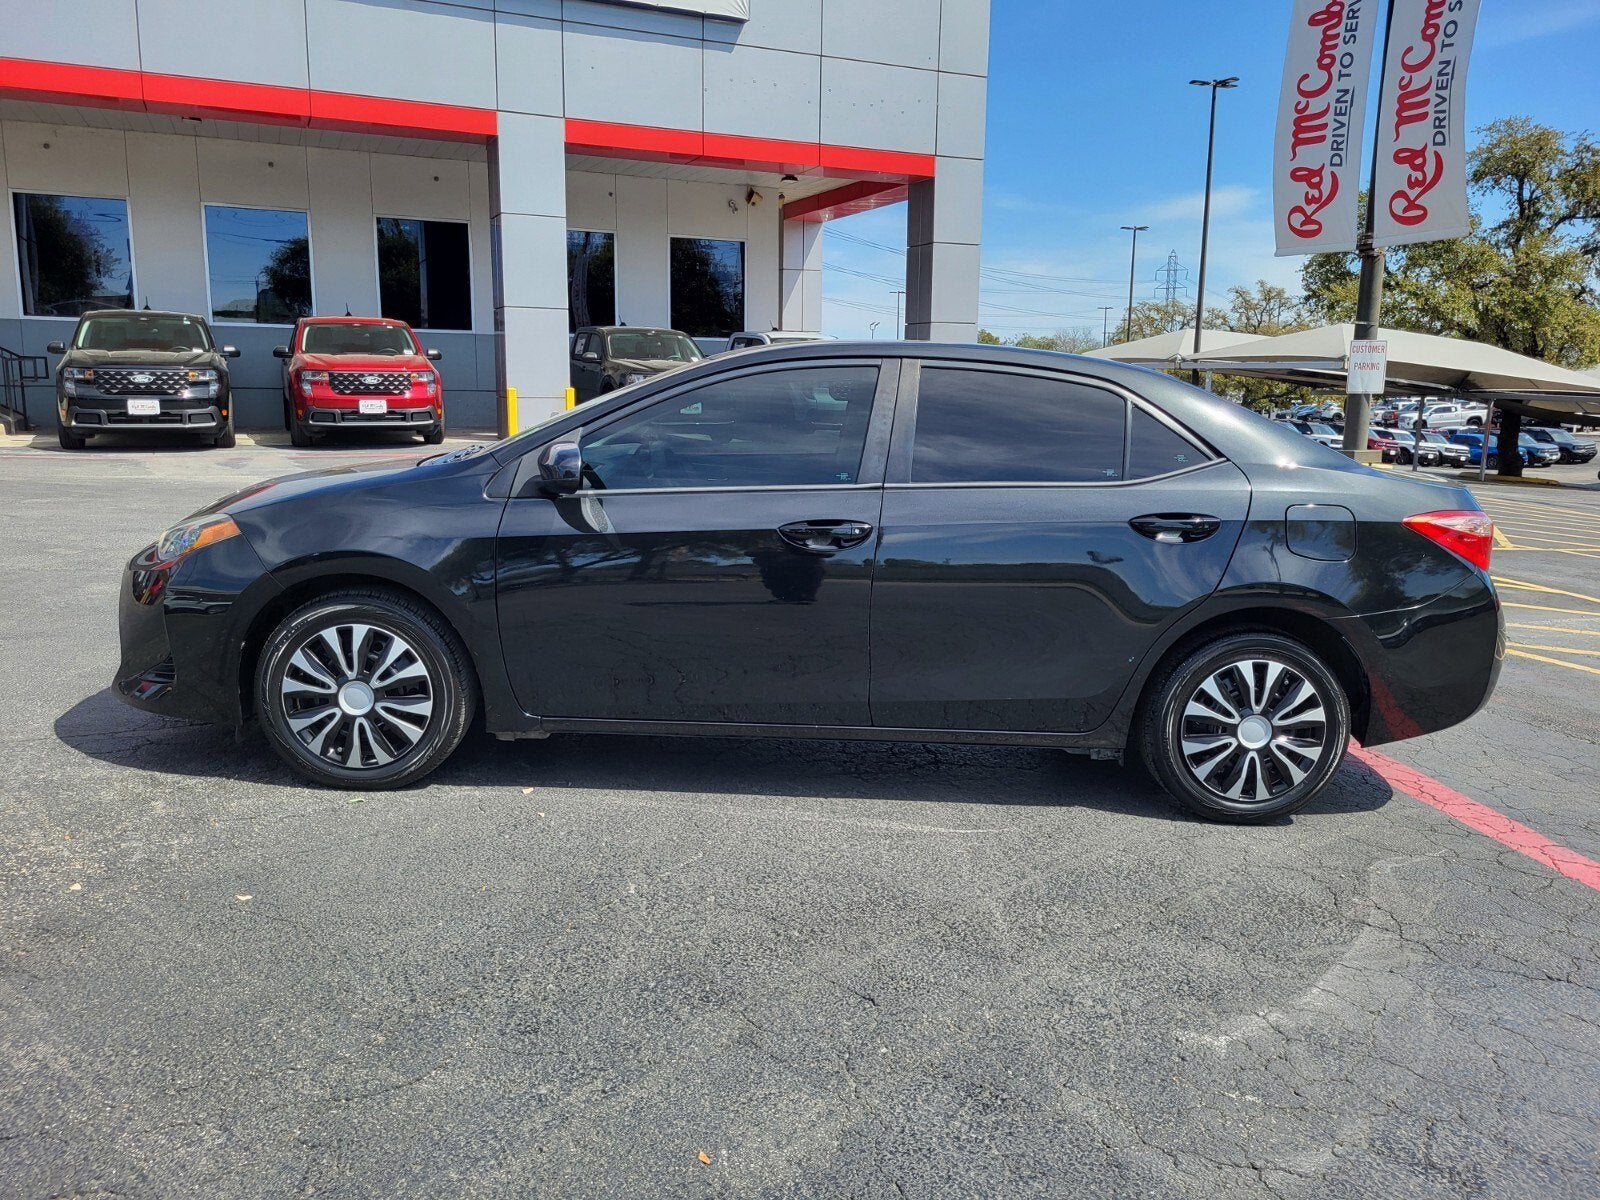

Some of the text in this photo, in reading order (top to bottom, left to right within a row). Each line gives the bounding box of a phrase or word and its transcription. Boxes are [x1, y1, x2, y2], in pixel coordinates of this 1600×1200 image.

[1440, 19, 1459, 54] TO
[1338, 51, 1355, 85] TO
[1330, 88, 1350, 168] DRIVEN
[1432, 59, 1450, 147] DRIVEN
[1287, 162, 1339, 239] Red
[1388, 142, 1444, 226] Red
[1351, 345, 1386, 354] CUSTOMER
[1353, 362, 1380, 371] PARKING
